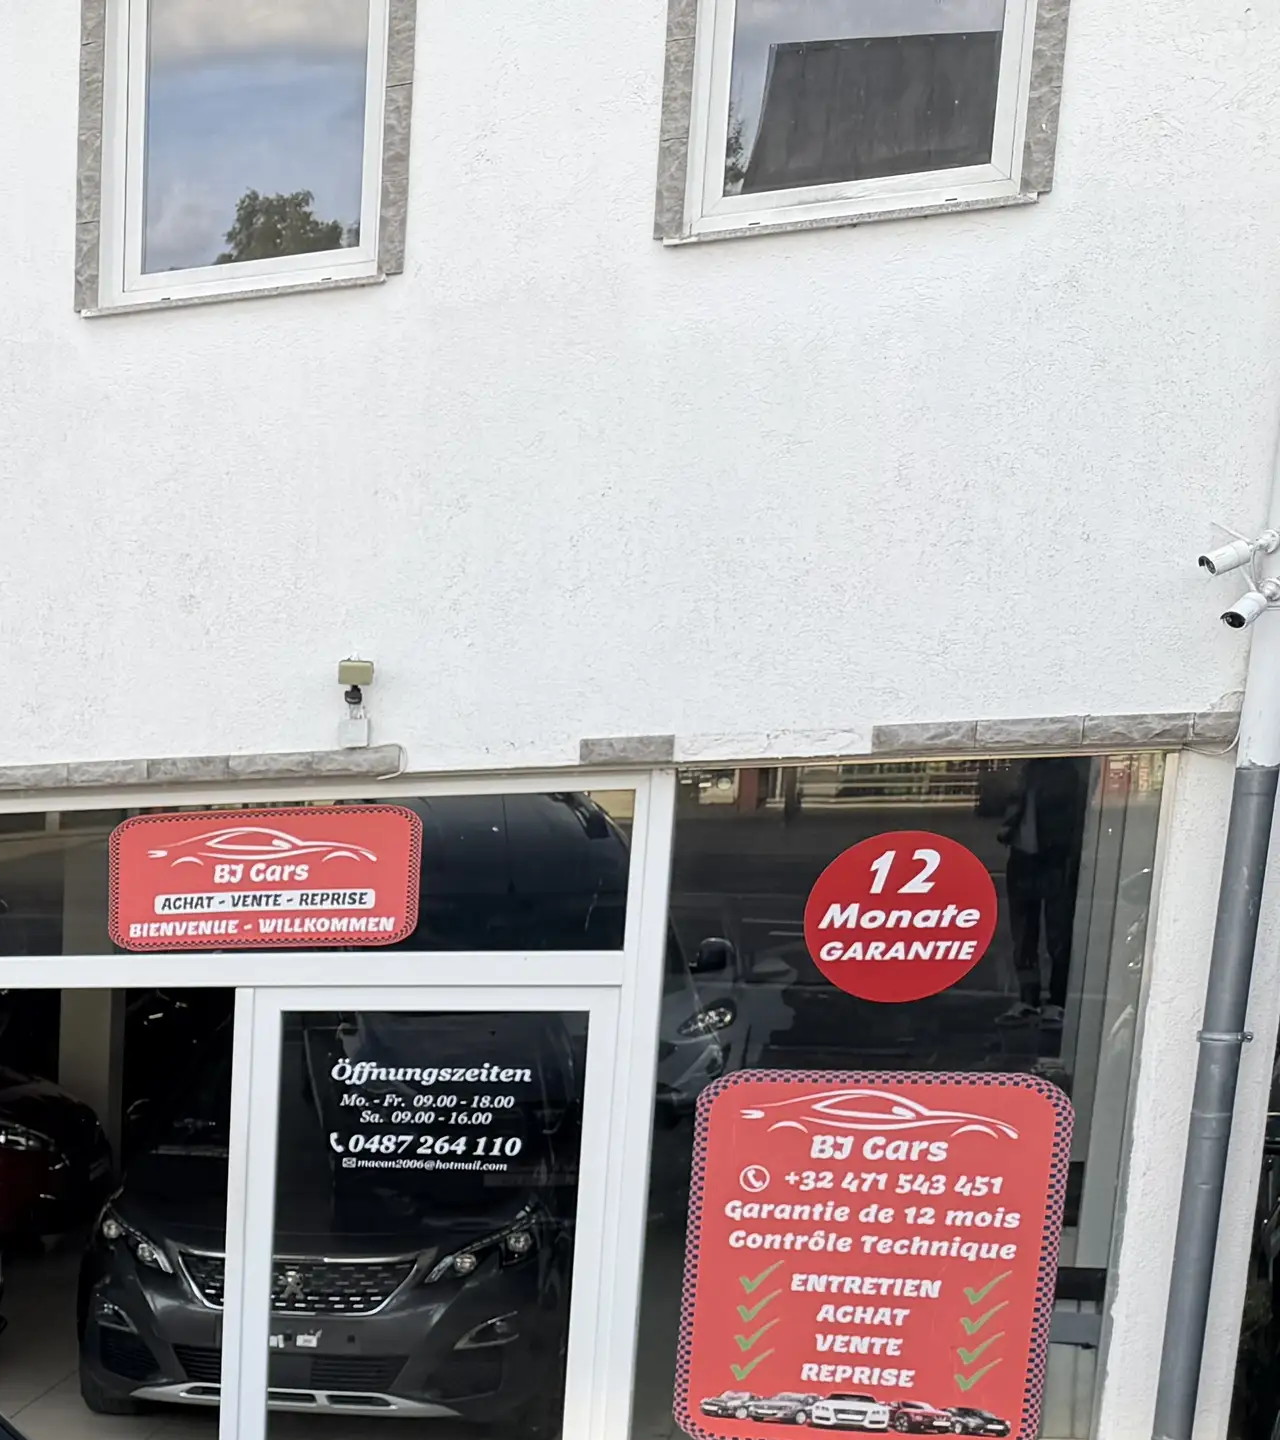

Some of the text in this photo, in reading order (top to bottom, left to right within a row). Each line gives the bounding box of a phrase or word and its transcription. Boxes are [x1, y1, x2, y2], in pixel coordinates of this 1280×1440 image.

[214, 863, 309, 884] BJ Cars
[869, 849, 941, 894] 12
[161, 895, 214, 911] ACHAT
[231, 893, 282, 908] VENTE
[299, 891, 368, 906] REPRISE
[129, 918, 239, 938] BIENVENUE
[259, 916, 396, 934] WILLKOMMEN
[818, 903, 980, 929] Monate
[819, 940, 978, 961] GARANTIE
[331, 1058, 532, 1085] Öffnungszeiten
[340, 1094, 369, 1107] Mo.
[383, 1094, 405, 1107] Fr.
[413, 1095, 457, 1108] 09.00
[470, 1096, 515, 1108] 18.00
[360, 1111, 383, 1123] Sa.
[391, 1112, 435, 1124] 09.00
[448, 1112, 492, 1124] 16.00
[348, 1134, 522, 1156] 0487 264 110
[810, 1134, 948, 1162] BJ Cars
[785, 1171, 1003, 1196] +32 471 543 451
[724, 1200, 1020, 1228] Garantie de 12 mois
[728, 1230, 1017, 1261] Contrôle Technique
[791, 1273, 942, 1298] ENTRETIEN
[816, 1304, 910, 1326] ACHAT
[815, 1334, 903, 1356] VENTE
[801, 1363, 916, 1387] REPRISE
